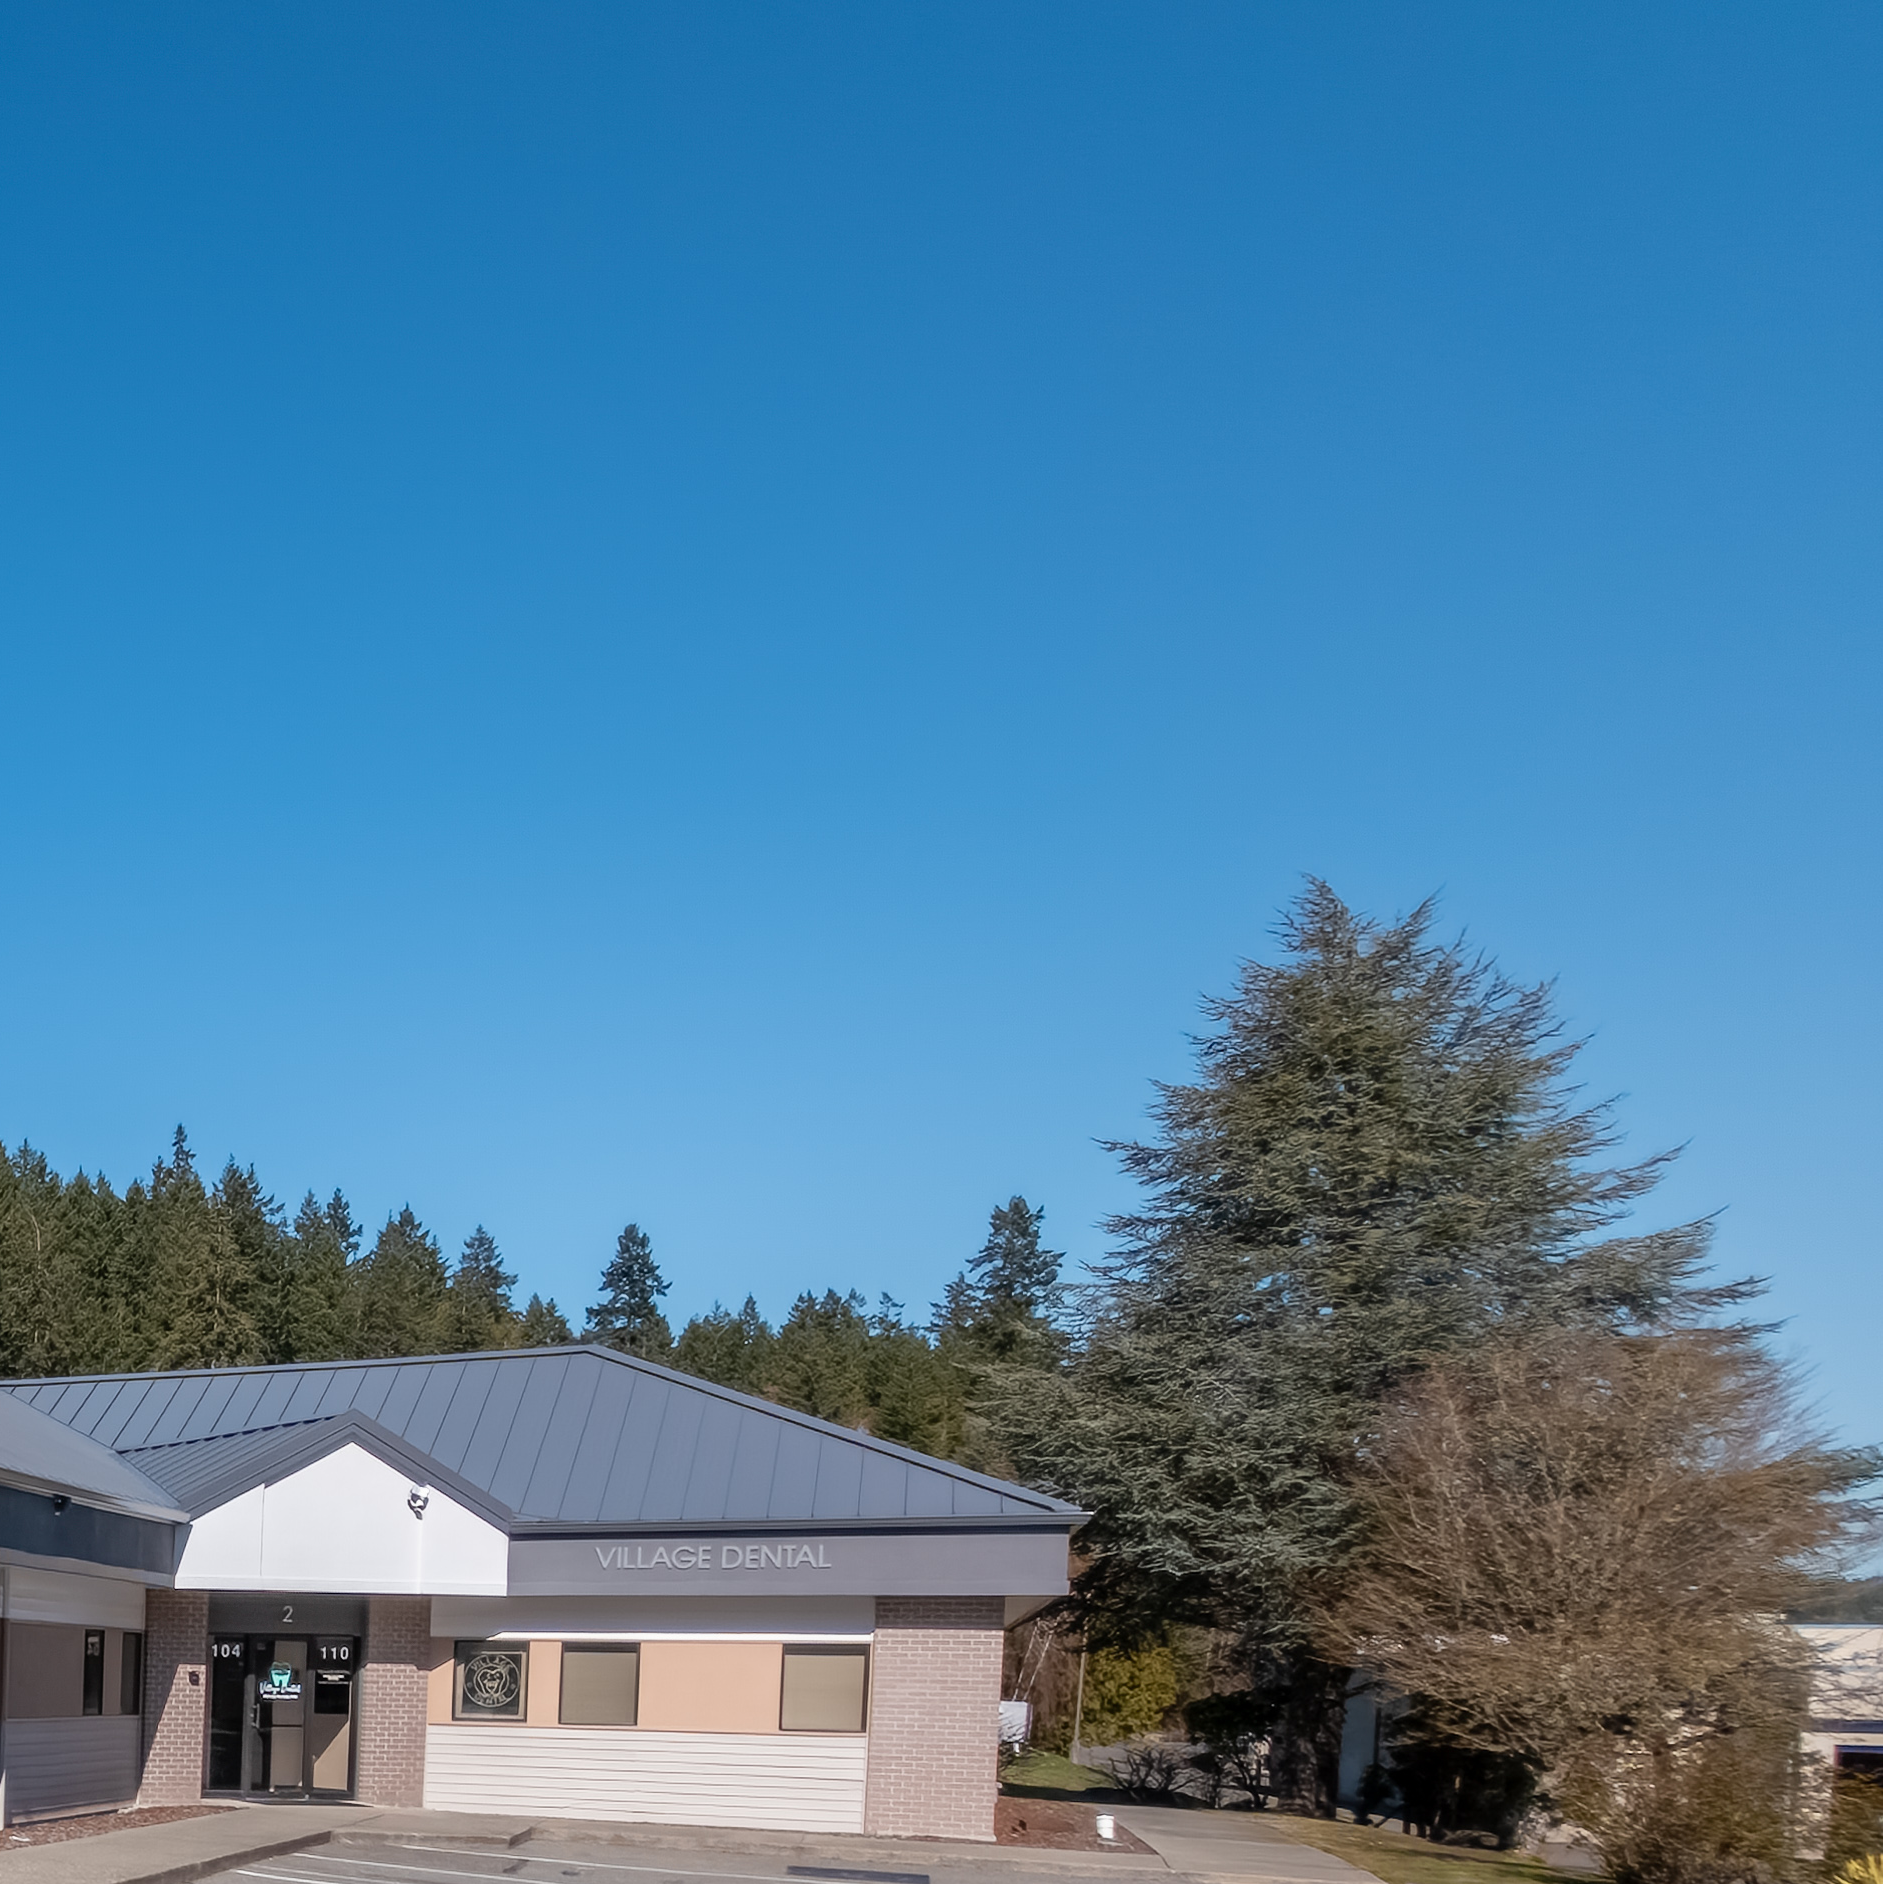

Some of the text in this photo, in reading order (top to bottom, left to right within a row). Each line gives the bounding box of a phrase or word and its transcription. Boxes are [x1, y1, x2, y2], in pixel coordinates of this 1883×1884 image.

[595, 1544, 832, 1569] VILLAGE DENTAL
[282, 1605, 294, 1623] 2
[211, 1643, 241, 1658] 104
[320, 1646, 350, 1660] 110
